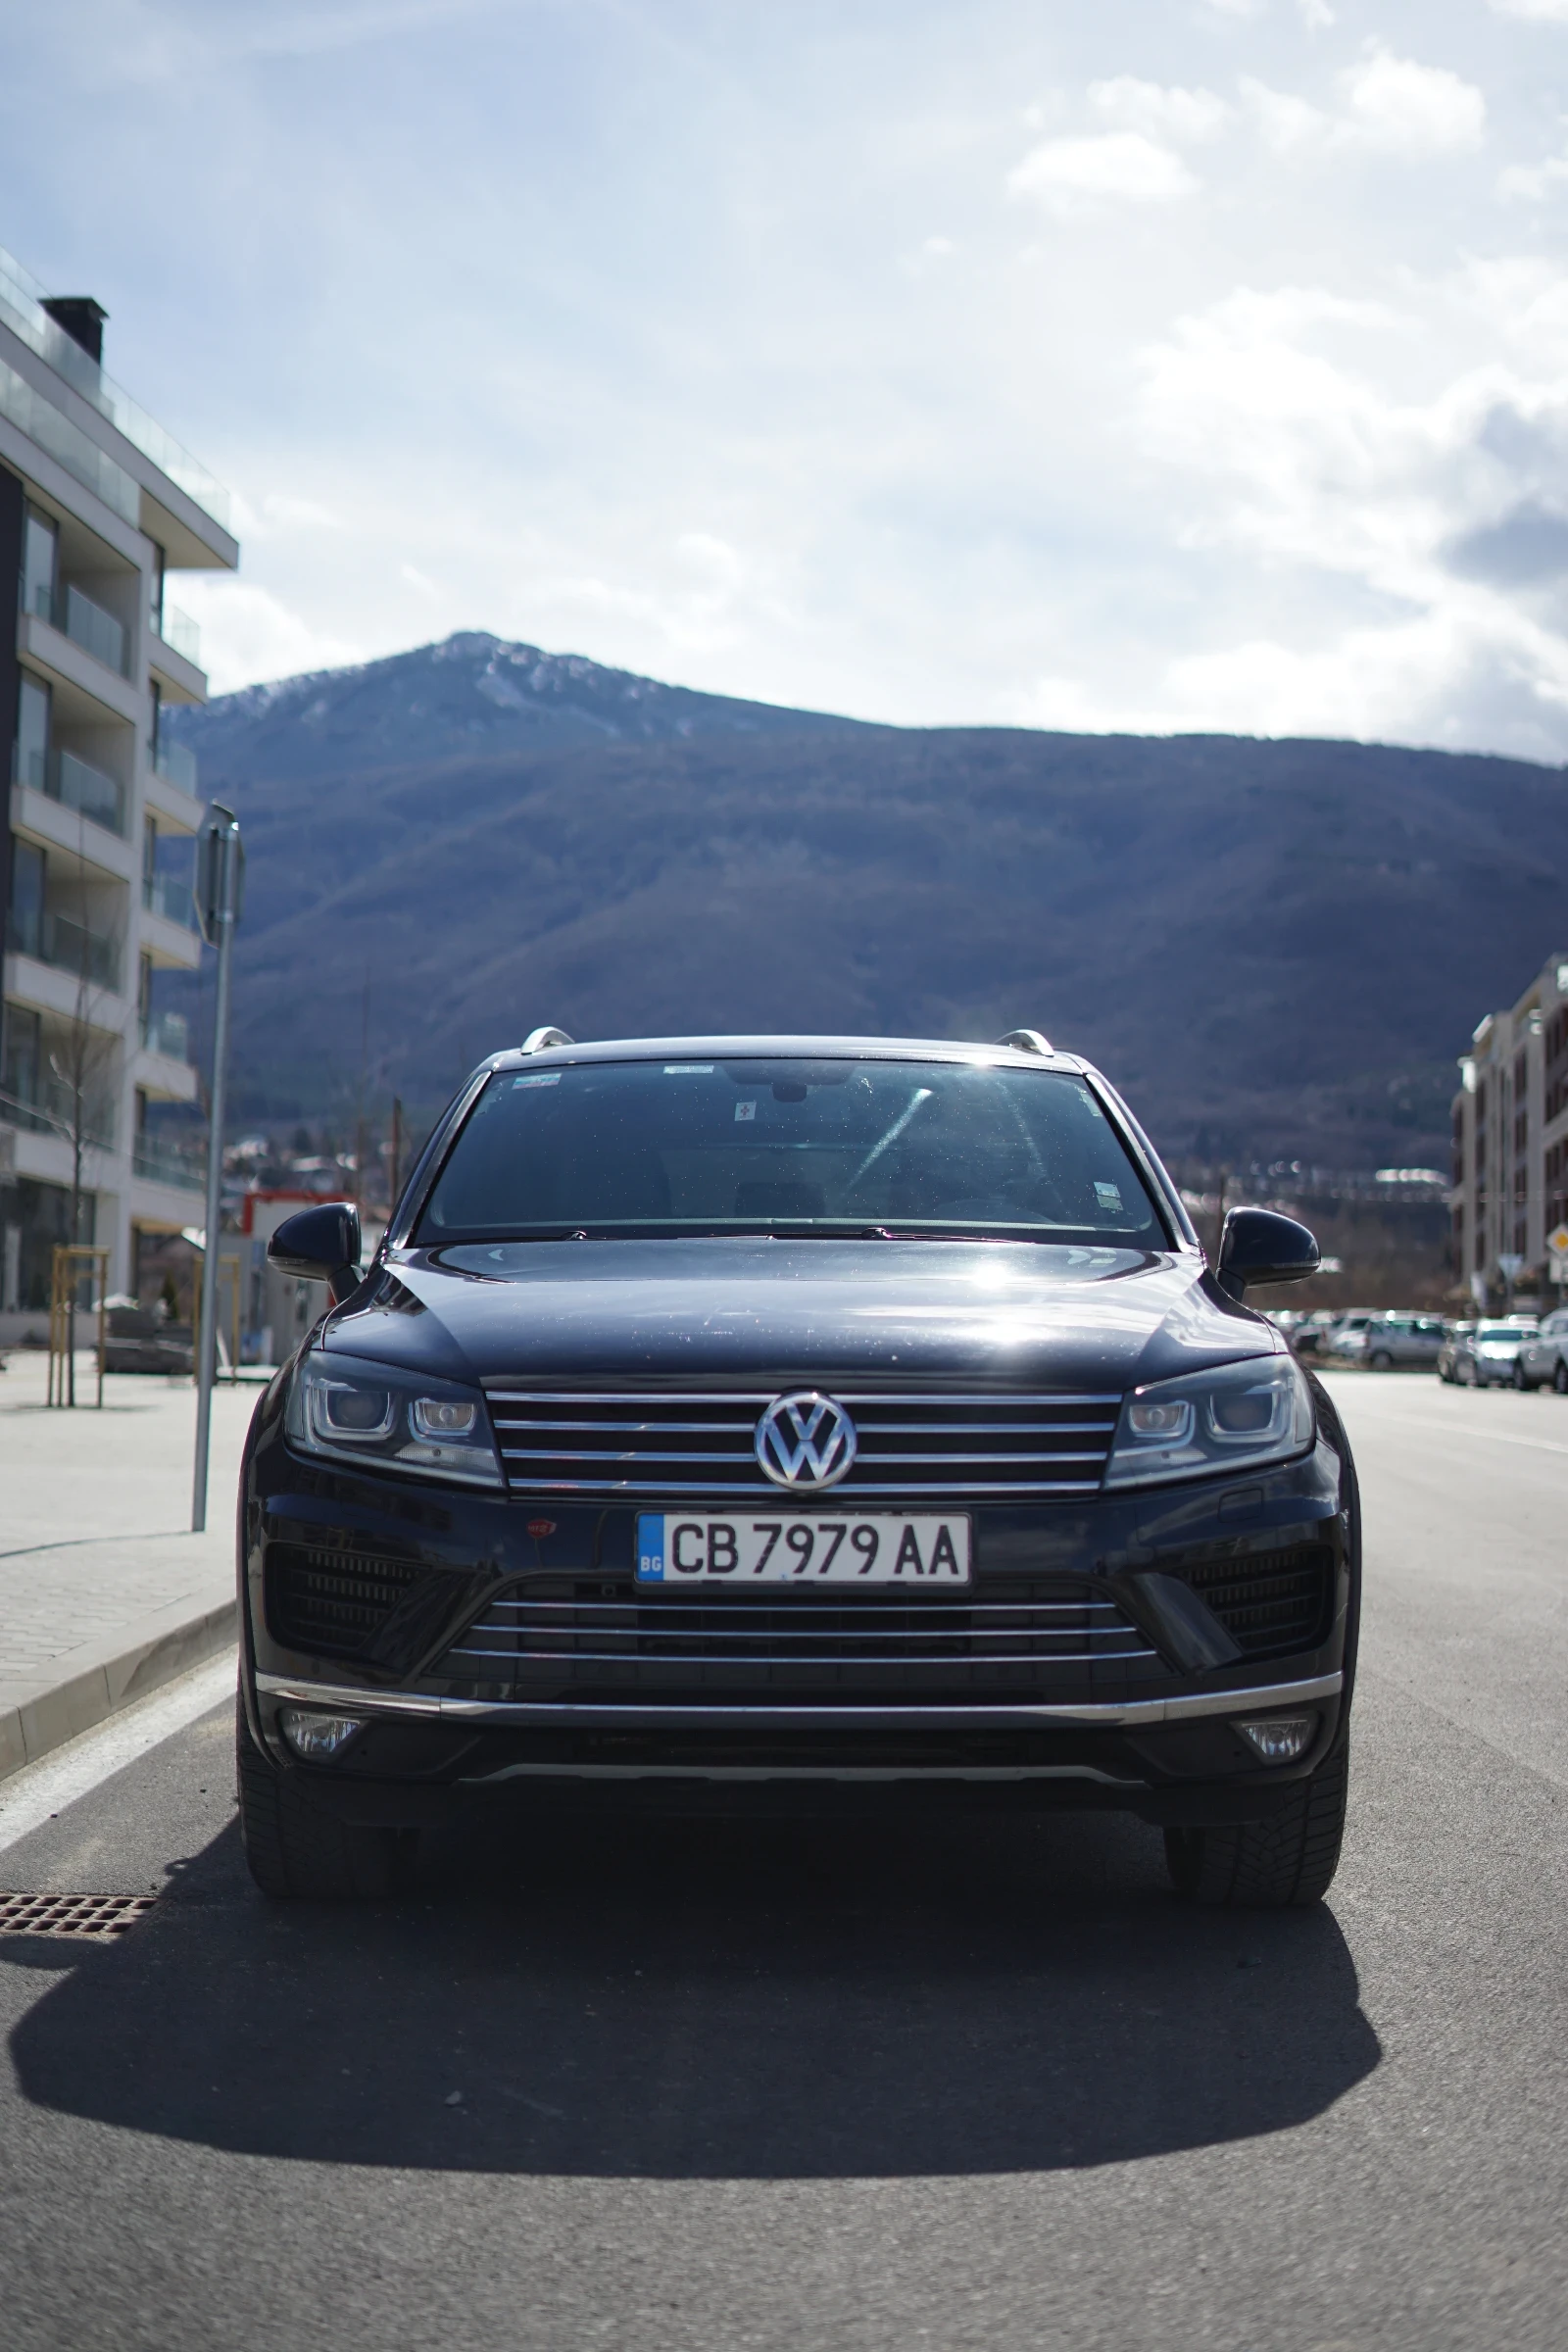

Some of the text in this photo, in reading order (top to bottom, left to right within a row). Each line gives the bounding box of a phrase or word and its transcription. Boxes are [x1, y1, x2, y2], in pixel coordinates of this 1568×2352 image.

[756, 1392, 856, 1492] VW
[640, 1555, 662, 1572] BG
[672, 1523, 959, 1575] CB 7979 AA
